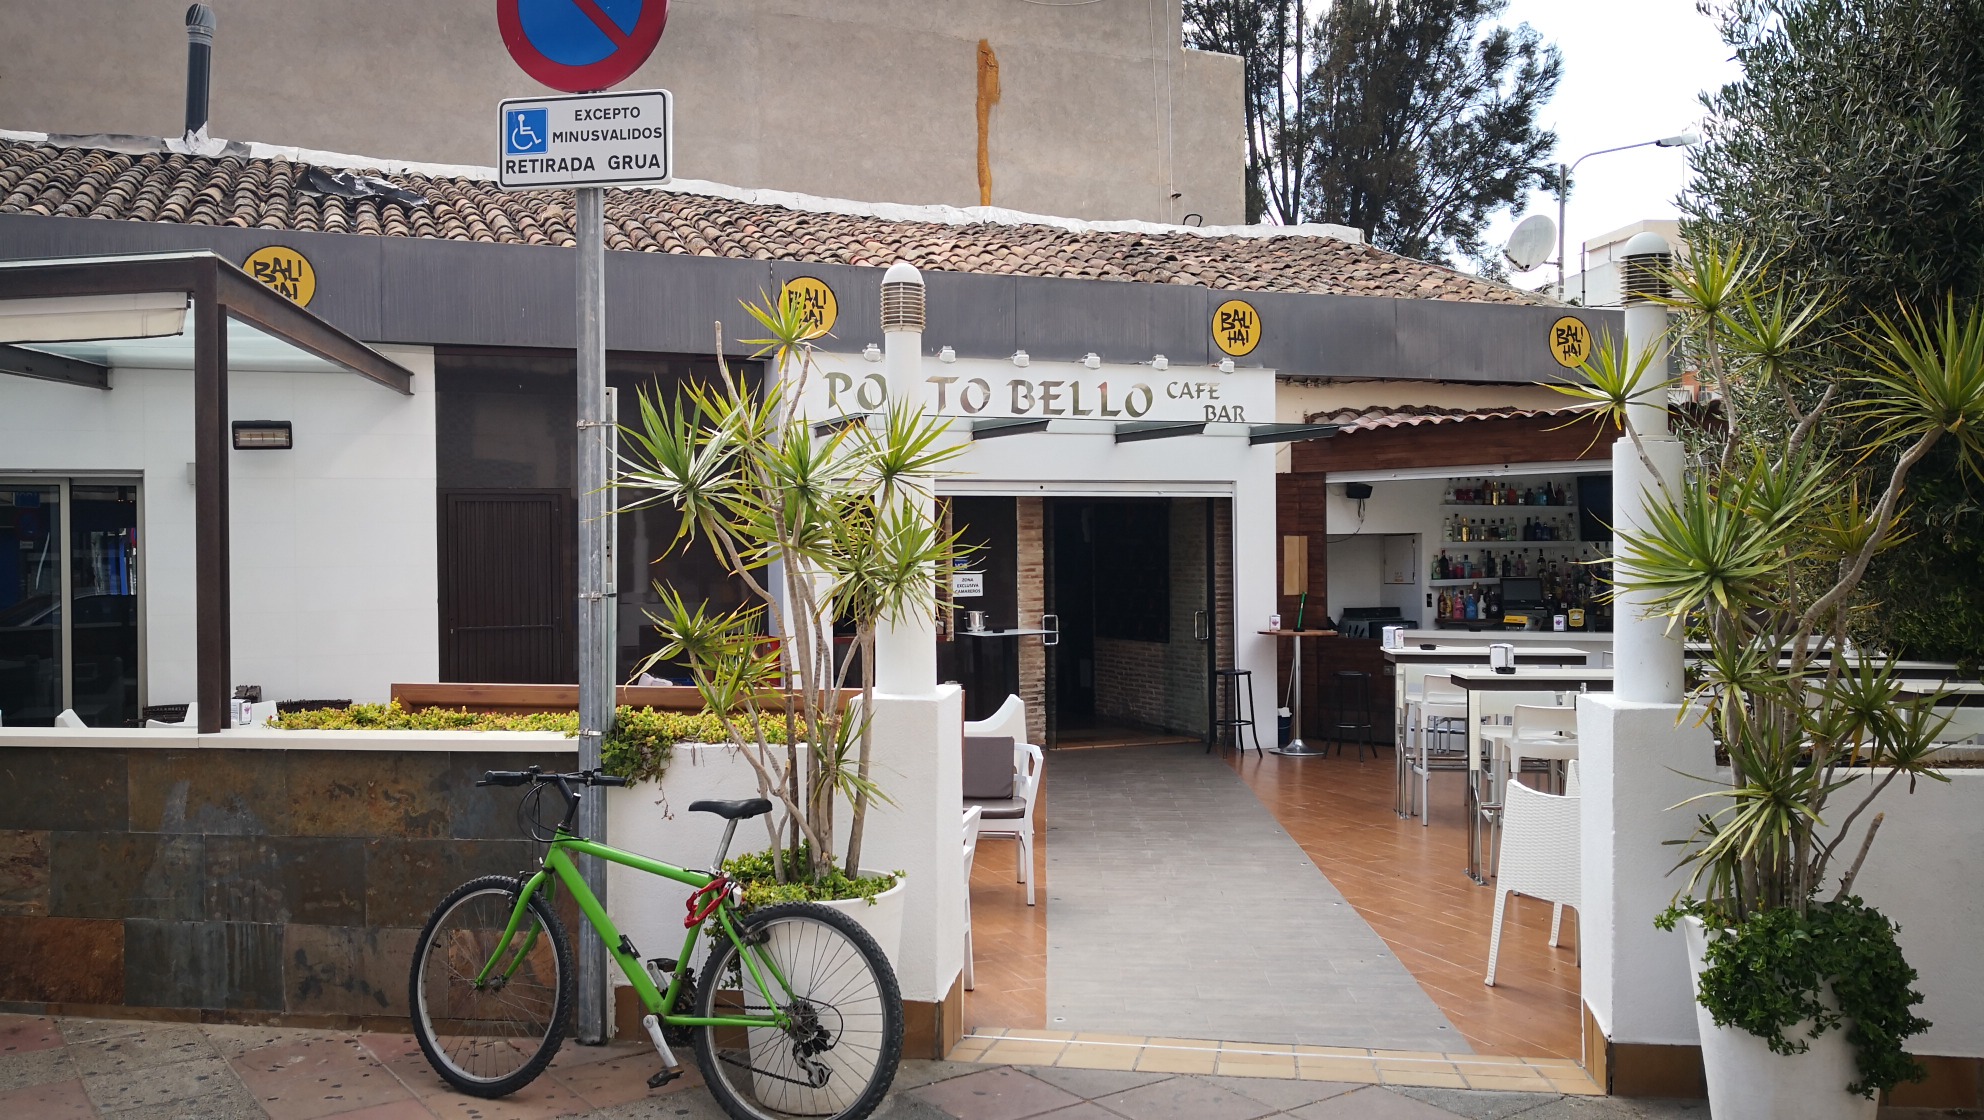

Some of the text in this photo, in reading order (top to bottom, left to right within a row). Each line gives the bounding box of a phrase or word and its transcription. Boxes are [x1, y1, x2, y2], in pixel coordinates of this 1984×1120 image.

[574, 106, 641, 122] EXCEPTO
[552, 127, 663, 143] MINUSVALIDOS
[505, 154, 661, 174] RETIRADA GRUA
[253, 257, 302, 283] BALI
[1220, 309, 1252, 332] BALI
[1227, 328, 1249, 348] HAI
[1556, 325, 1583, 347] BALI
[1563, 343, 1581, 361] HAI
[824, 371, 1221, 418] POTO BELLO CAFE
[1203, 404, 1246, 423] BAR
